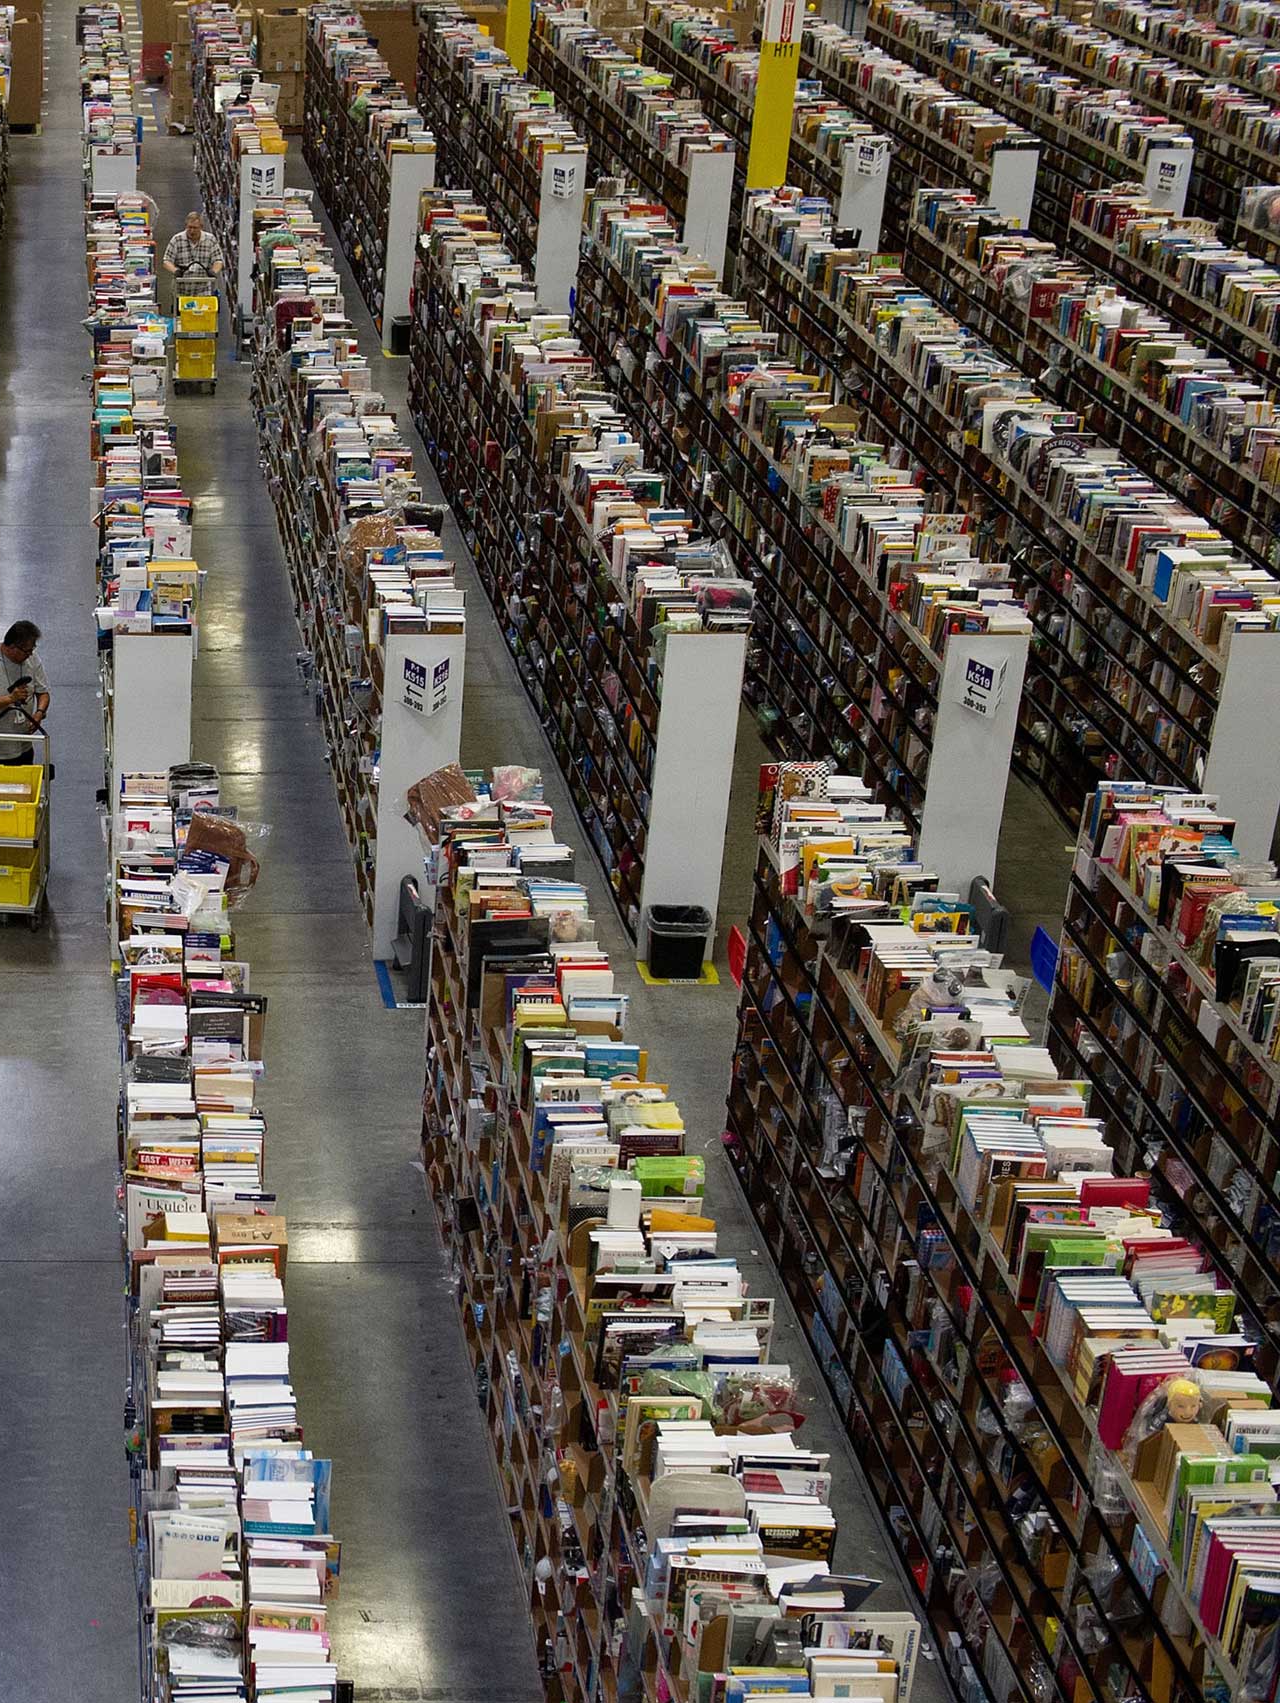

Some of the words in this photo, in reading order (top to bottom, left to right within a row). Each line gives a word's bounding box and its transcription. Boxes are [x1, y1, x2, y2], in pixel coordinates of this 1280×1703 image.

[774, 44, 794, 57] H11
[410, 663, 420, 675] P-1
[976, 666, 986, 676] P-1
[405, 669, 425, 687] K515
[968, 672, 991, 689] K519
[140, 1155, 160, 1165] EAST
[168, 1157, 192, 1167] WEST
[146, 1199, 197, 1212] Ukulele
[675, 1569, 733, 1584] HOBBIT
